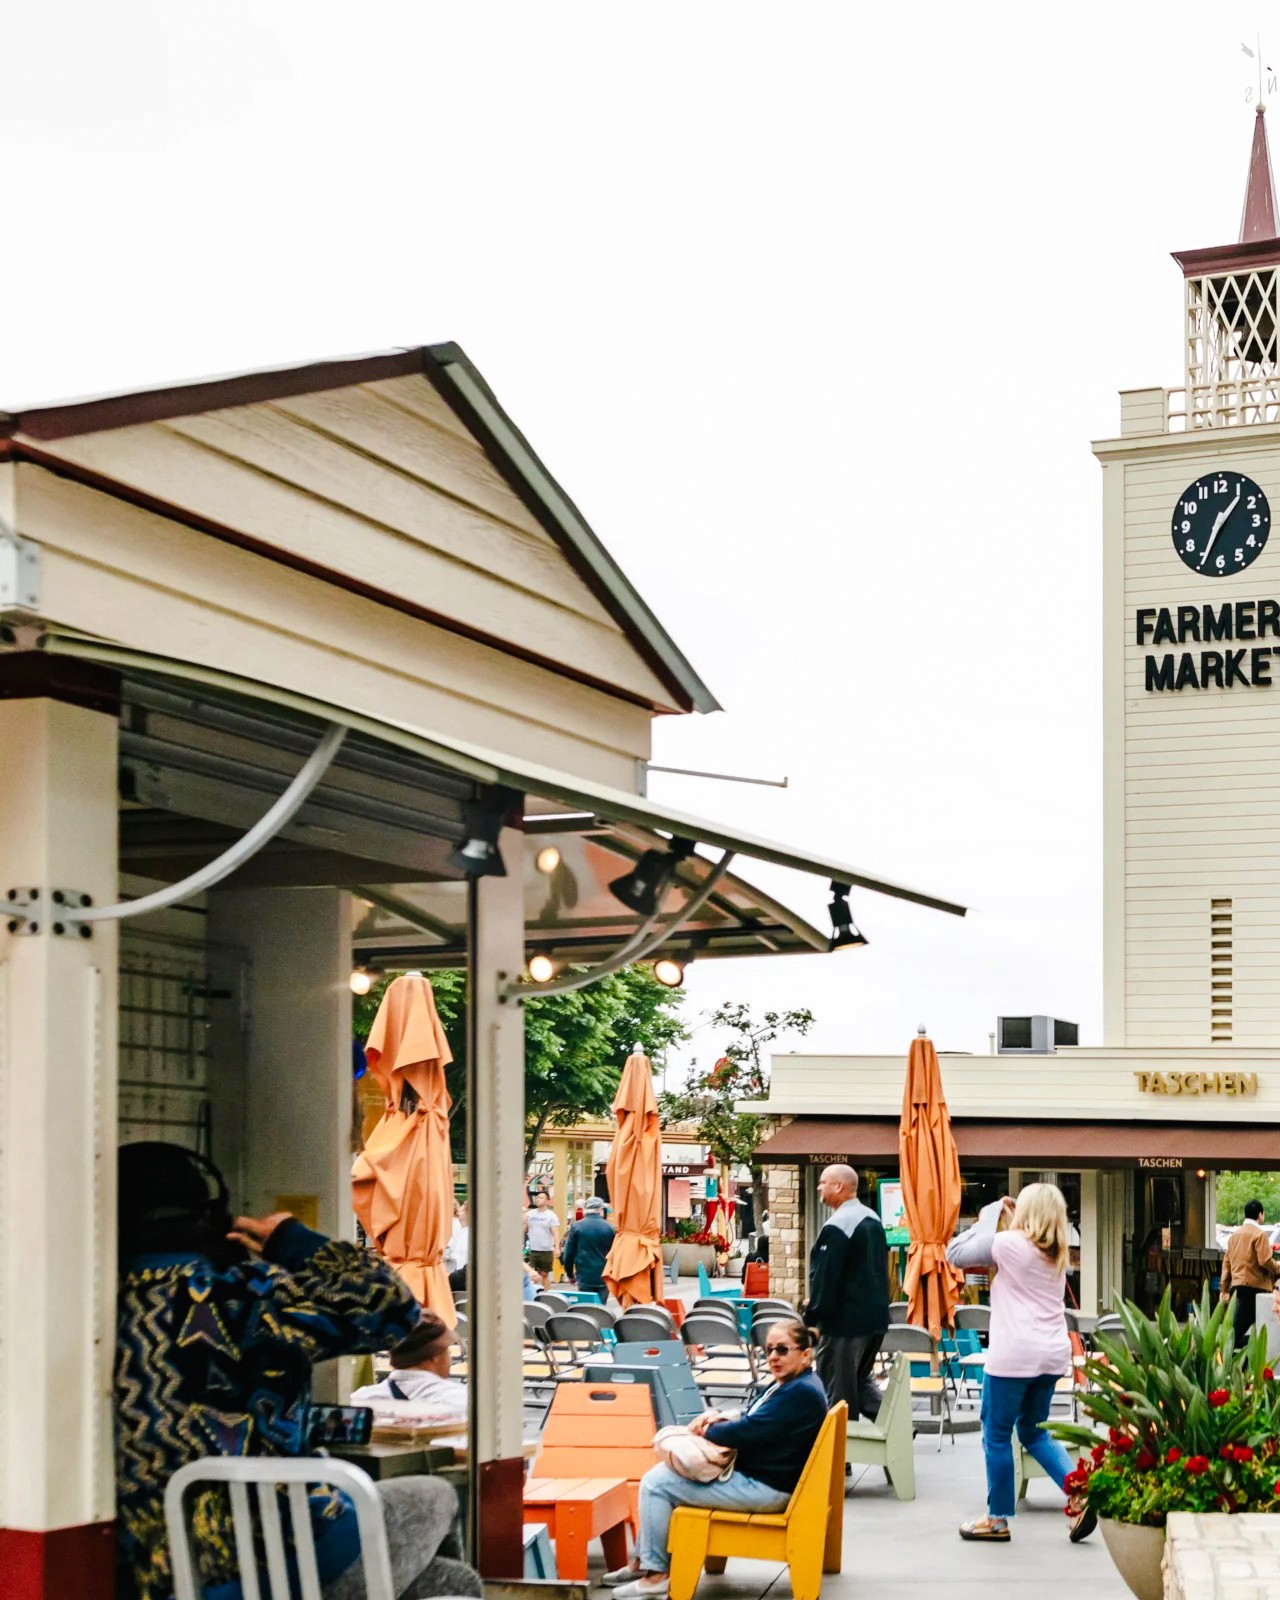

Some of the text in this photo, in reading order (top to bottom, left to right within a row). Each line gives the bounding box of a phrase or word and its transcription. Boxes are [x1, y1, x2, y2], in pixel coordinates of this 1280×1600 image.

[1198, 486, 1209, 500] 11
[1213, 479, 1228, 494] 12
[1184, 501, 1198, 515] 10
[1246, 495, 1257, 510] 2
[1181, 520, 1191, 534] 9
[1251, 514, 1261, 528] 3
[1185, 538, 1196, 552] 8
[1245, 534, 1256, 547] 4
[1215, 554, 1226, 569] 6
[1234, 548, 1244, 562] 5
[1133, 1071, 1258, 1096] TASCHEN
[808, 1154, 848, 1164] TASCHEN
[1138, 1158, 1183, 1168] TASCHEN
[661, 1165, 690, 1174] TAND
